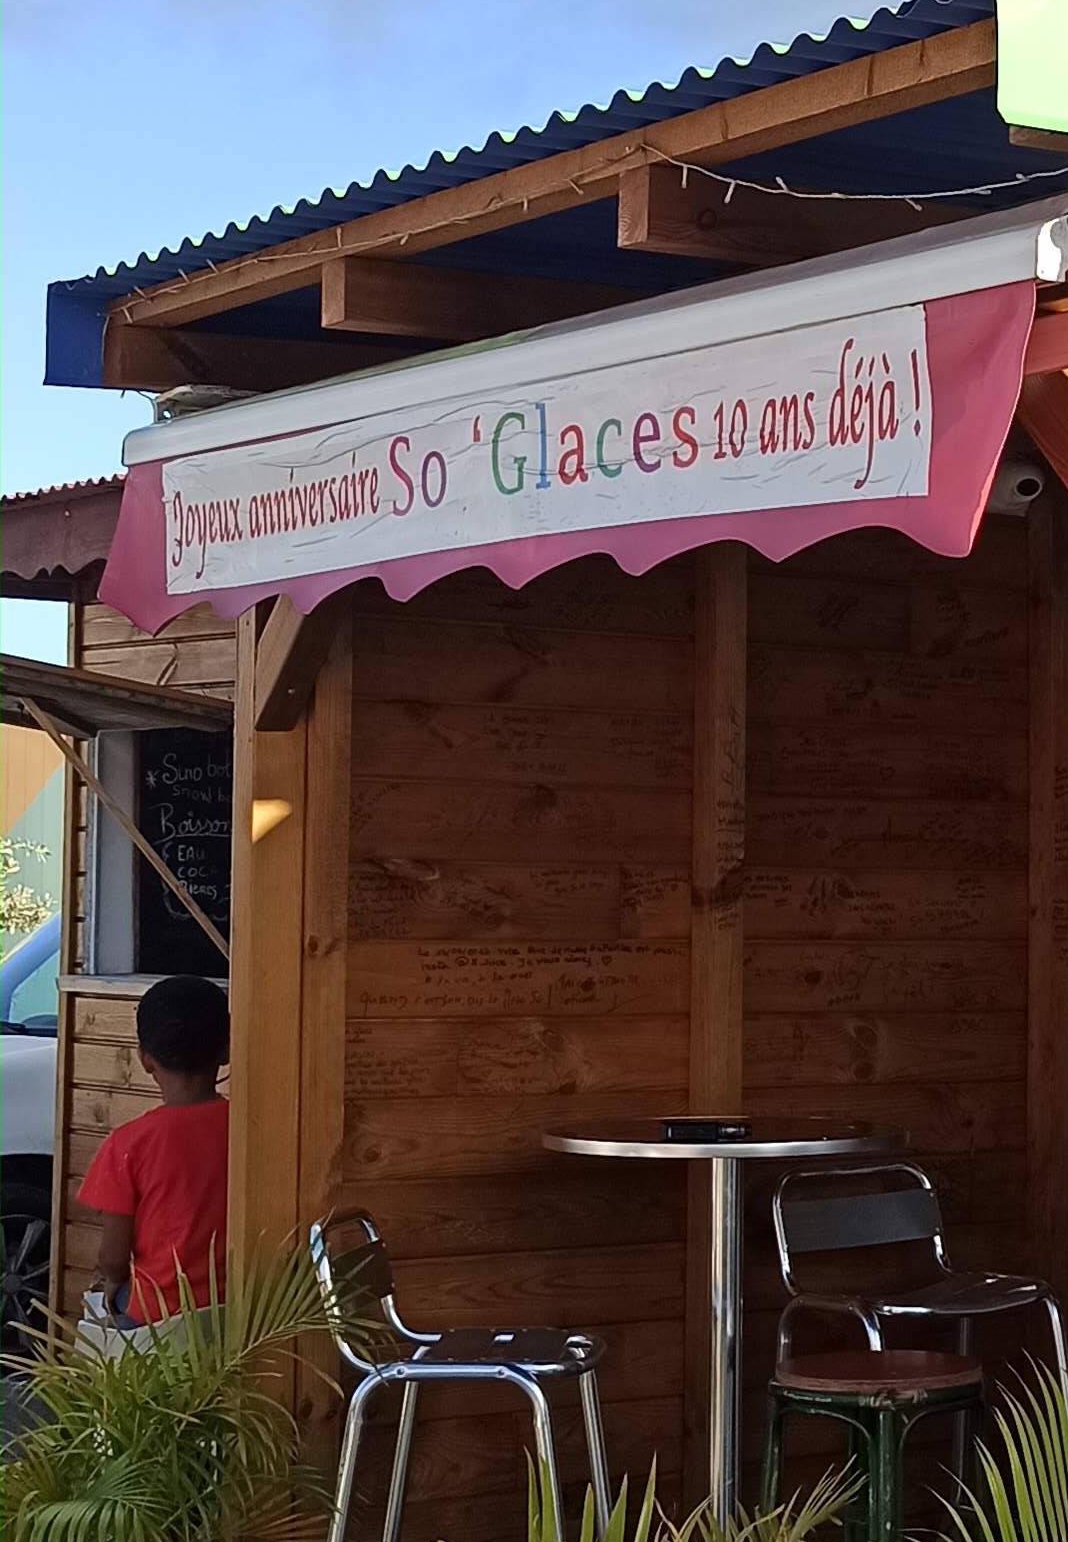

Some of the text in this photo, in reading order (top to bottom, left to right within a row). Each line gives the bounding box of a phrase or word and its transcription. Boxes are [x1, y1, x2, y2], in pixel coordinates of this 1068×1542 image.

[172, 490, 244, 580] Joyeux
[249, 451, 381, 539] anniversaire
[389, 435, 448, 517] So
[712, 399, 749, 460] 10
[759, 388, 816, 455] ans
[828, 337, 899, 490] déjà
